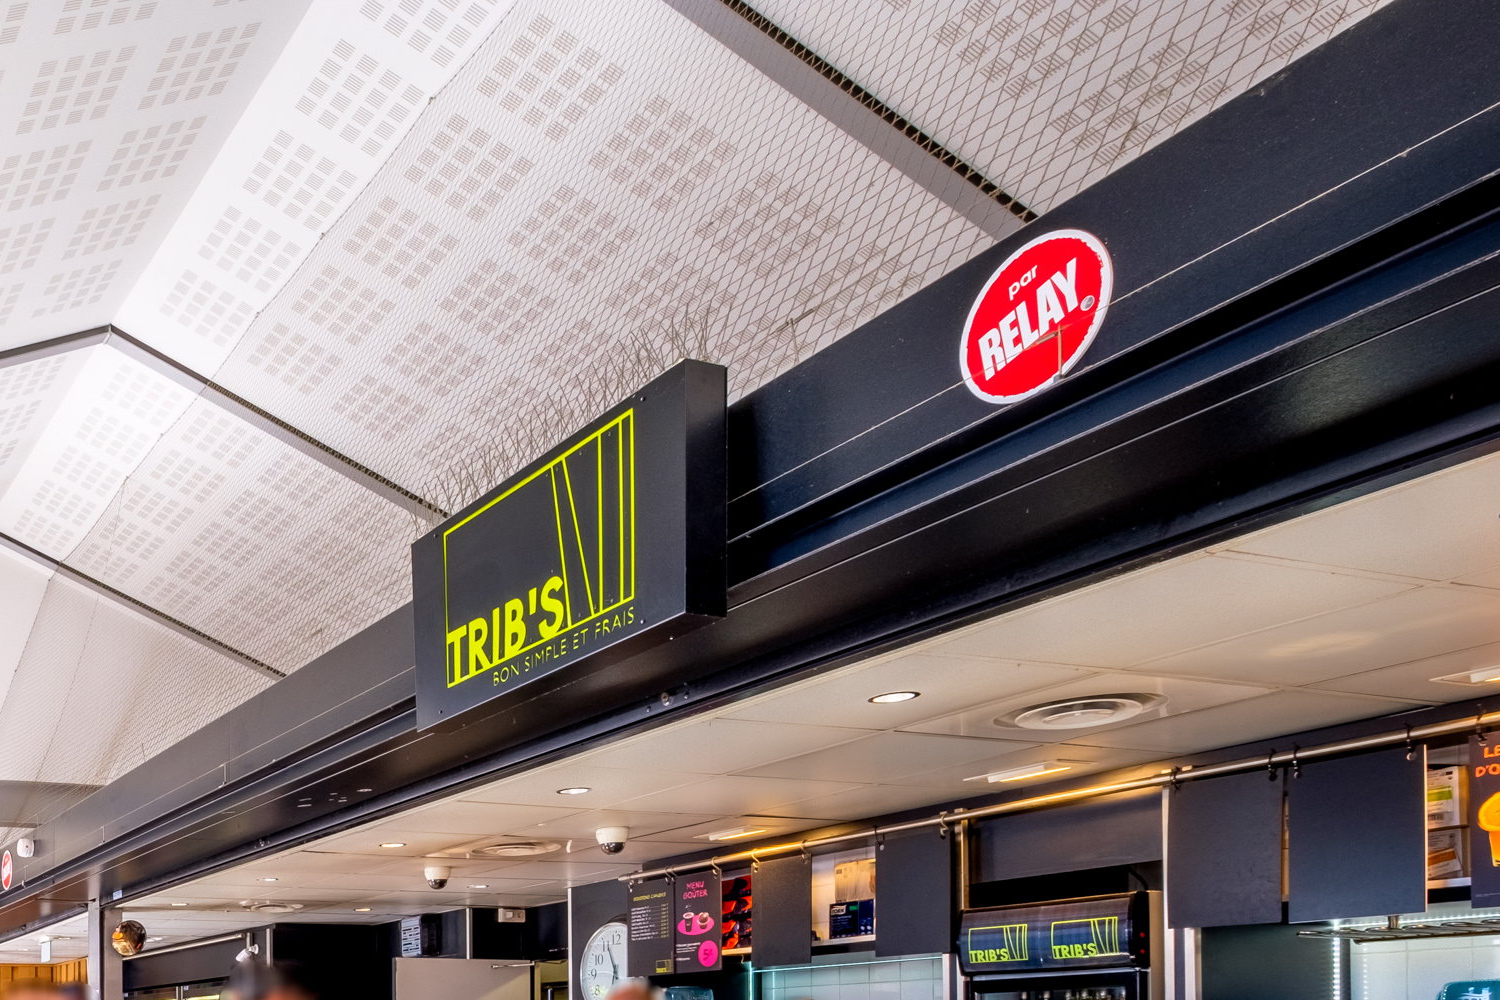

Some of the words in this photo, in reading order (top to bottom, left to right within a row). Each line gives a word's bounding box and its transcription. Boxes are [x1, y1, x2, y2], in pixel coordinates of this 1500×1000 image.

[1008, 264, 1039, 302] par
[978, 257, 1079, 381] RELAY
[446, 575, 565, 684] TRIB'S
[493, 663, 520, 687] BON
[525, 637, 567, 672] SIMPLE
[572, 627, 588, 650] ET
[595, 606, 635, 640] FRAIS
[686, 880, 705, 890] MENU
[682, 889, 708, 900] GOÛTER
[611, 933, 622, 945] 12
[602, 940, 610, 952] 11
[1053, 943, 1097, 958] TRIB'S
[594, 953, 604, 966] 10
[969, 947, 1008, 963] TRIB'S
[590, 968, 597, 981] 9
[594, 984, 601, 996] 8
